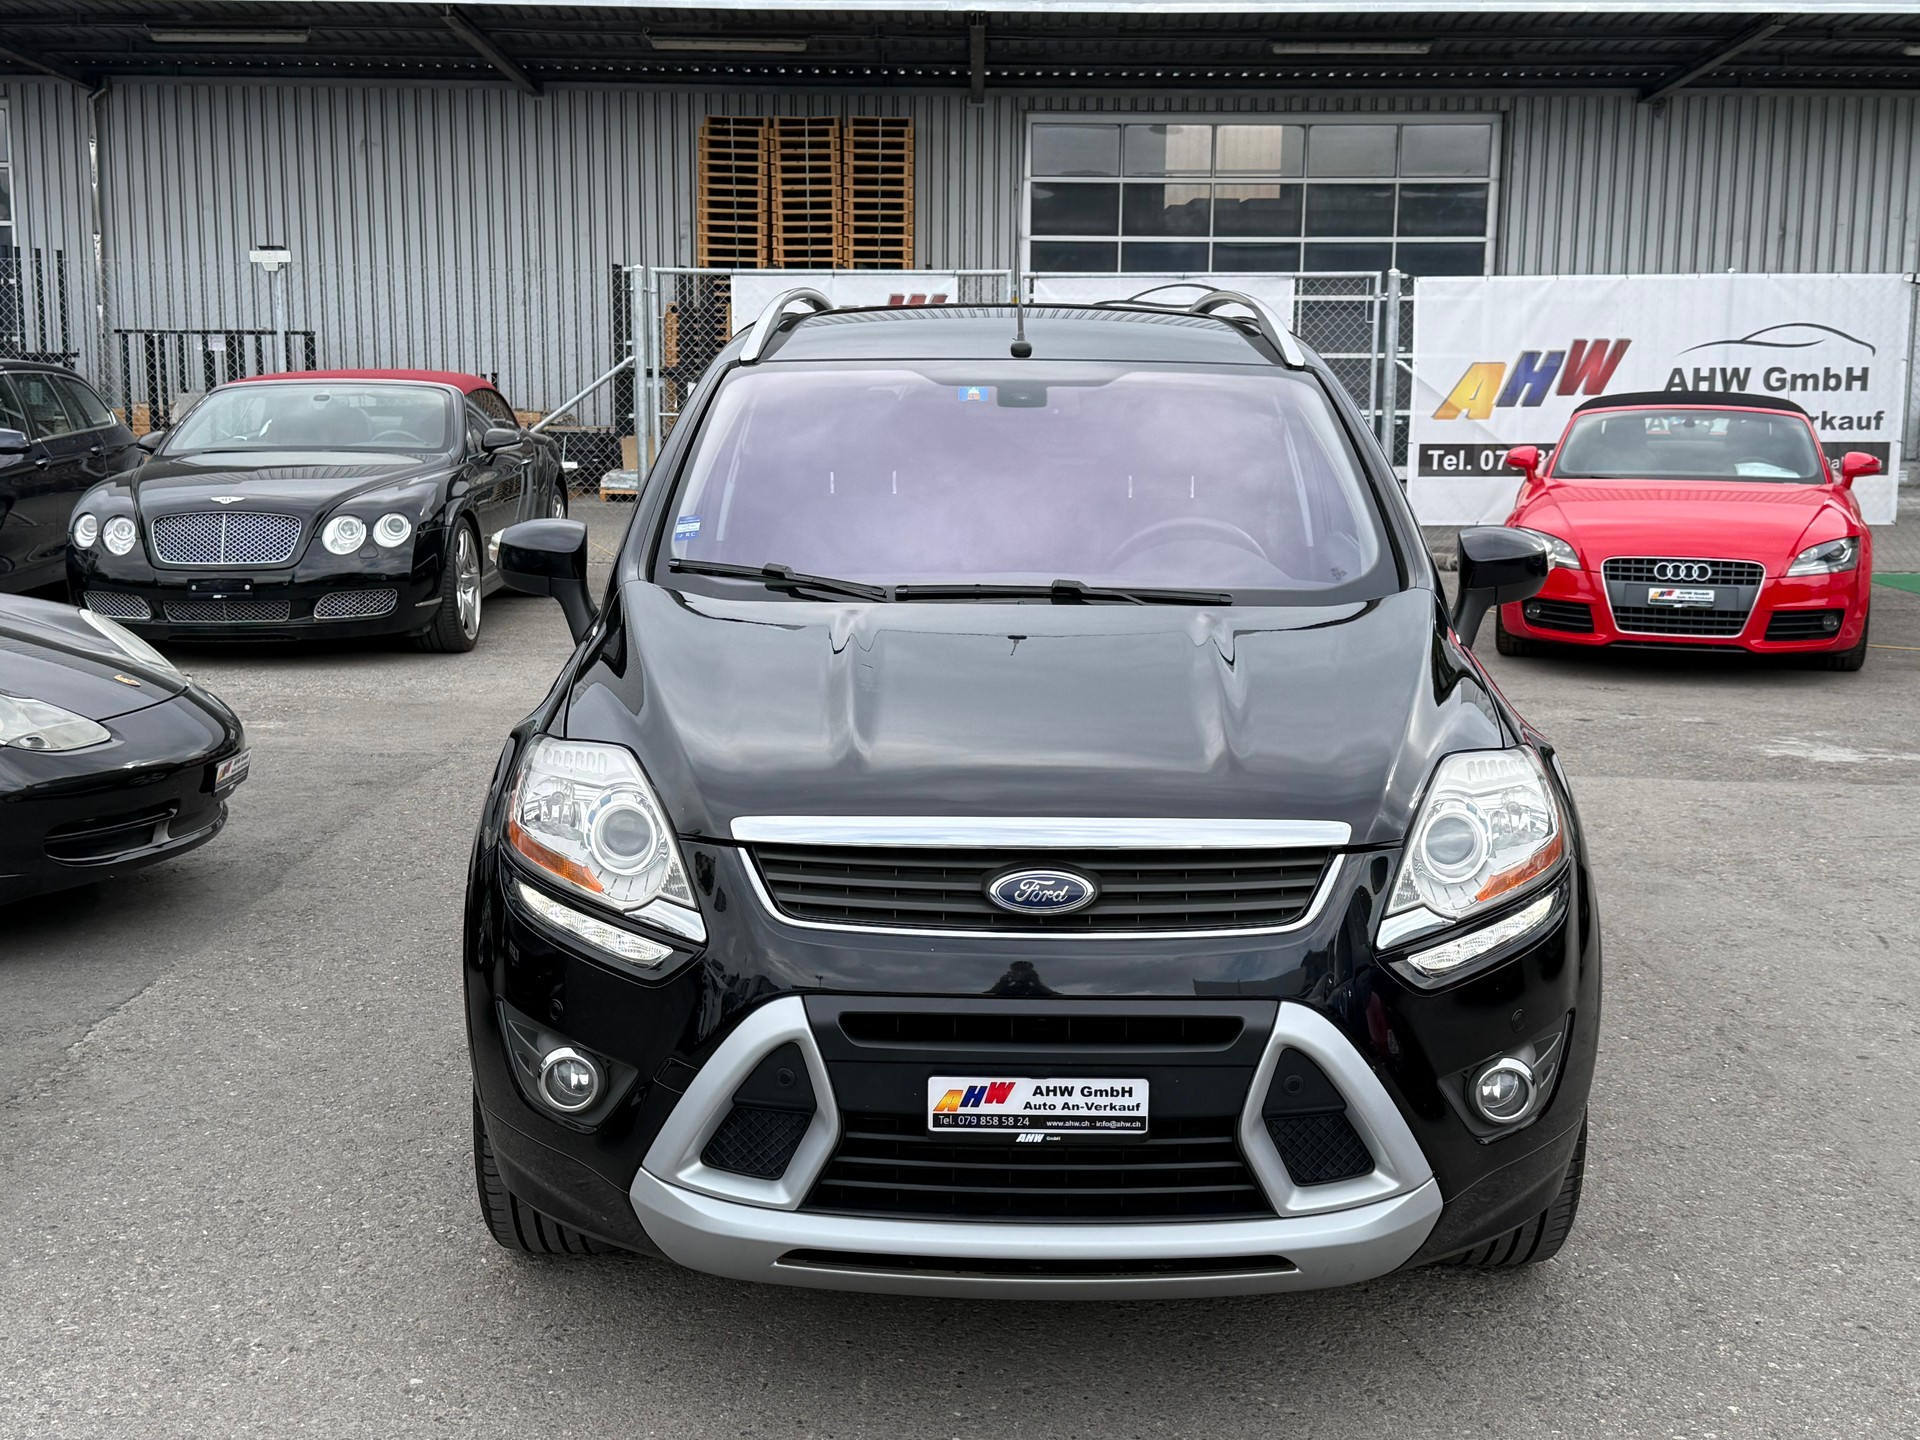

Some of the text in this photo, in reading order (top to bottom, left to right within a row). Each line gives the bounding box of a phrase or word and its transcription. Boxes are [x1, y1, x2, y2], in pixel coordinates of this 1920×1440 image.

[1431, 338, 1632, 420] AHW
[1664, 366, 1869, 392] AHW GmbH
[1427, 449, 1472, 471] Tel.
[1480, 449, 1520, 471] 07
[1014, 879, 1069, 902] Ford
[933, 1082, 1016, 1112] AHW
[1032, 1085, 1133, 1098] AHW GmbH
[1023, 1101, 1141, 1112] Auto An-Verkauf
[938, 1115, 1030, 1126] Tel. 079 858 58 24
[1096, 1120, 1141, 1128] info@ahw.ch
[1016, 1133, 1045, 1143] AHW
